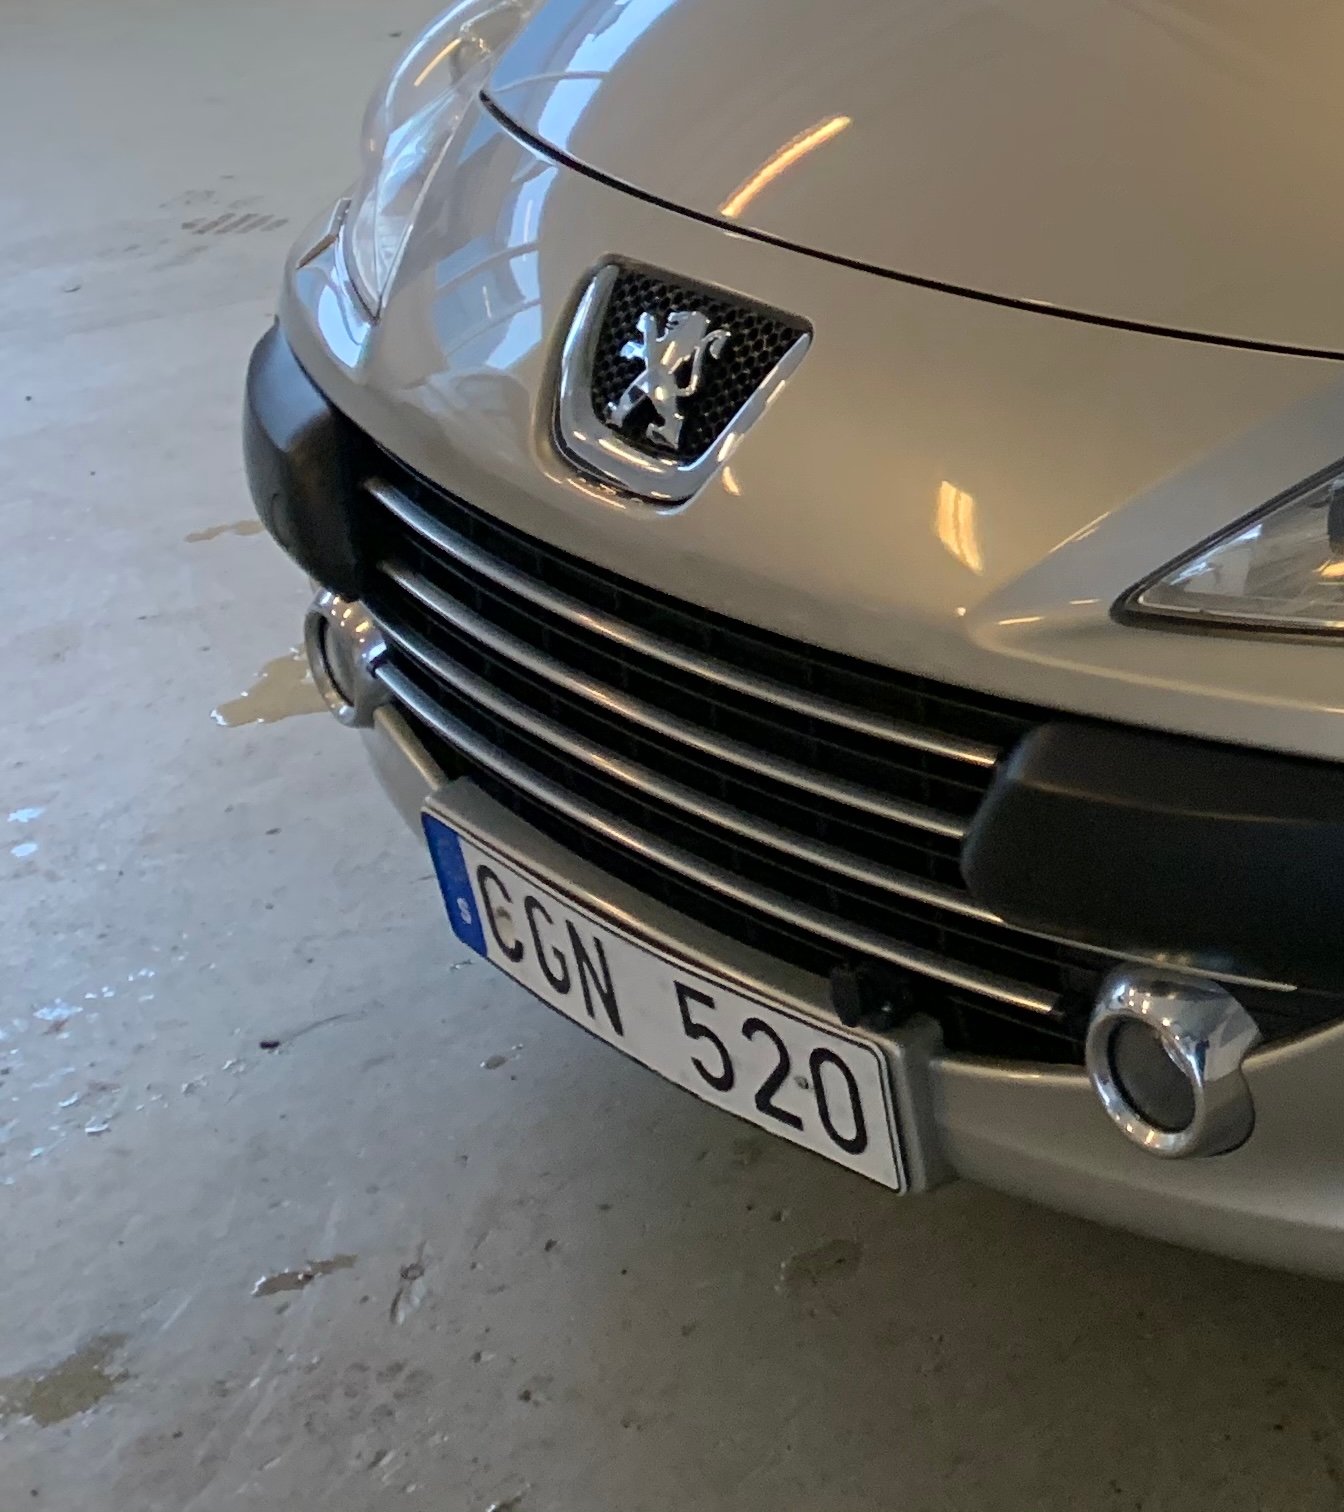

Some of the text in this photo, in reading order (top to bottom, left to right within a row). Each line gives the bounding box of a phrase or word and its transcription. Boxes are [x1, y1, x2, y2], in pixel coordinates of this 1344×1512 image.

[456, 897, 473, 925] S
[476, 864, 869, 1156] CGN 520
